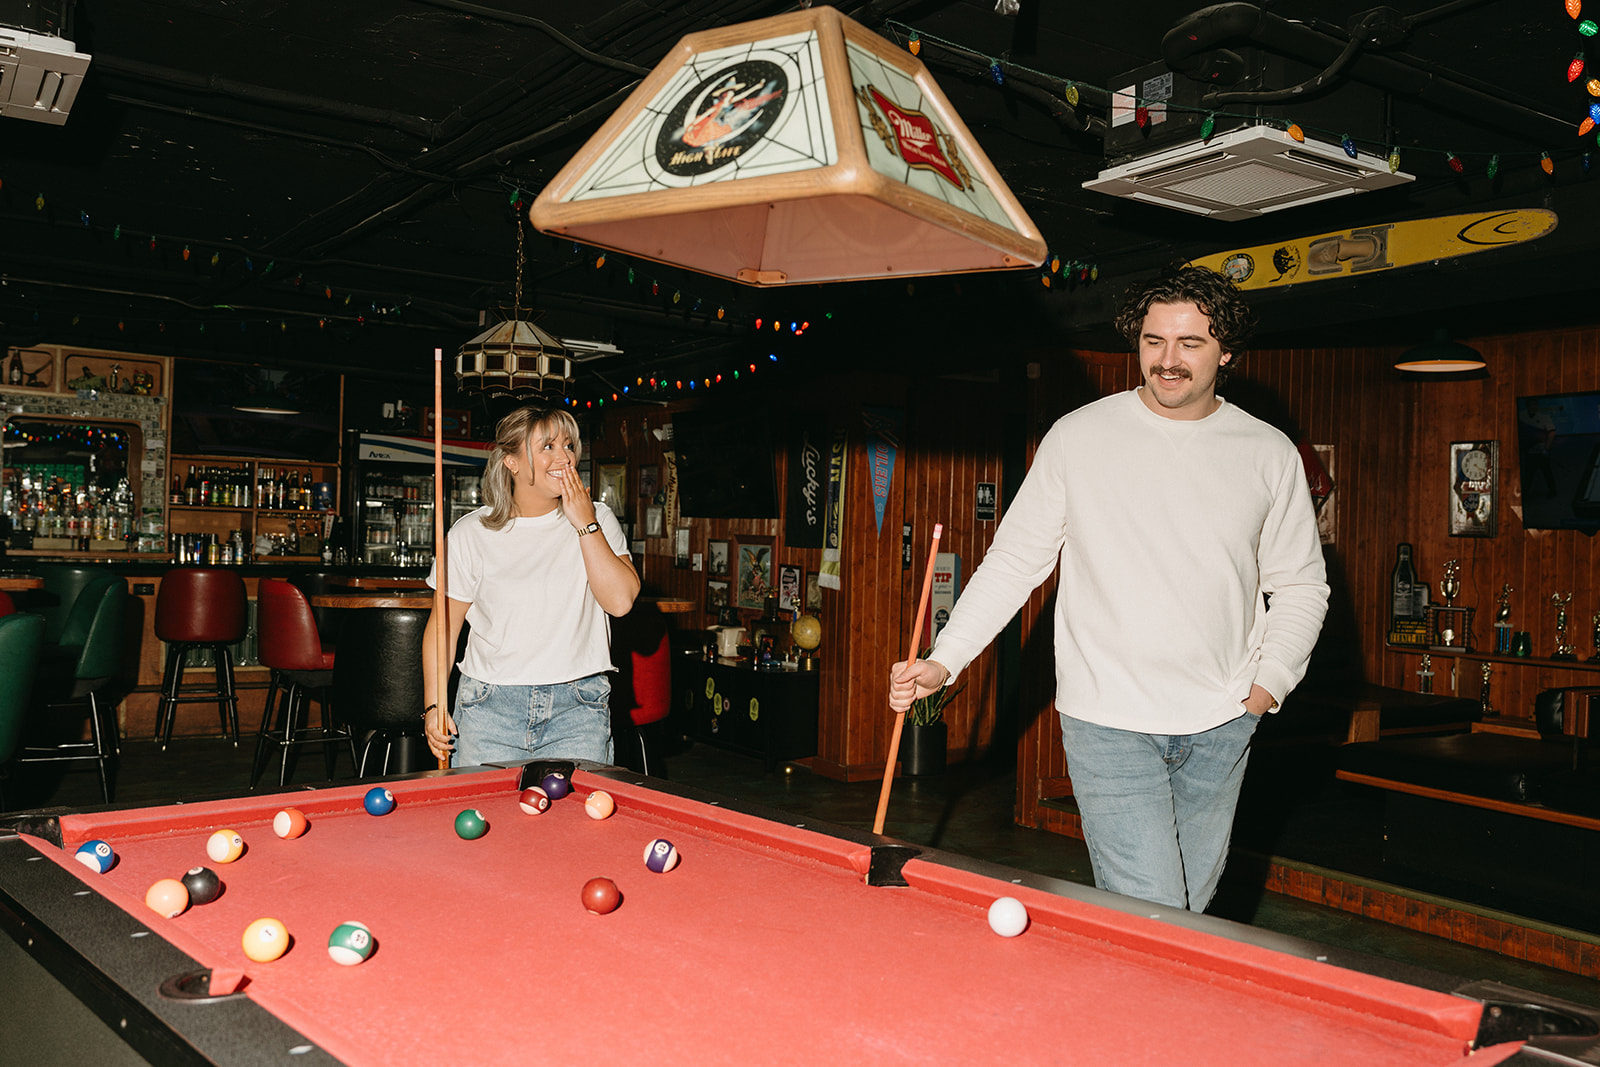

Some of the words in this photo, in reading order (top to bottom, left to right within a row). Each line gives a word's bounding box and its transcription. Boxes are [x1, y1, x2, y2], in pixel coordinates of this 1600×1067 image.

[888, 110, 932, 142] Miller
[668, 150, 704, 166] HIGH
[801, 431, 821, 526] Lucky's
[874, 441, 889, 498] OILERS
[934, 572, 952, 583] TIP
[98, 844, 108, 854] 10
